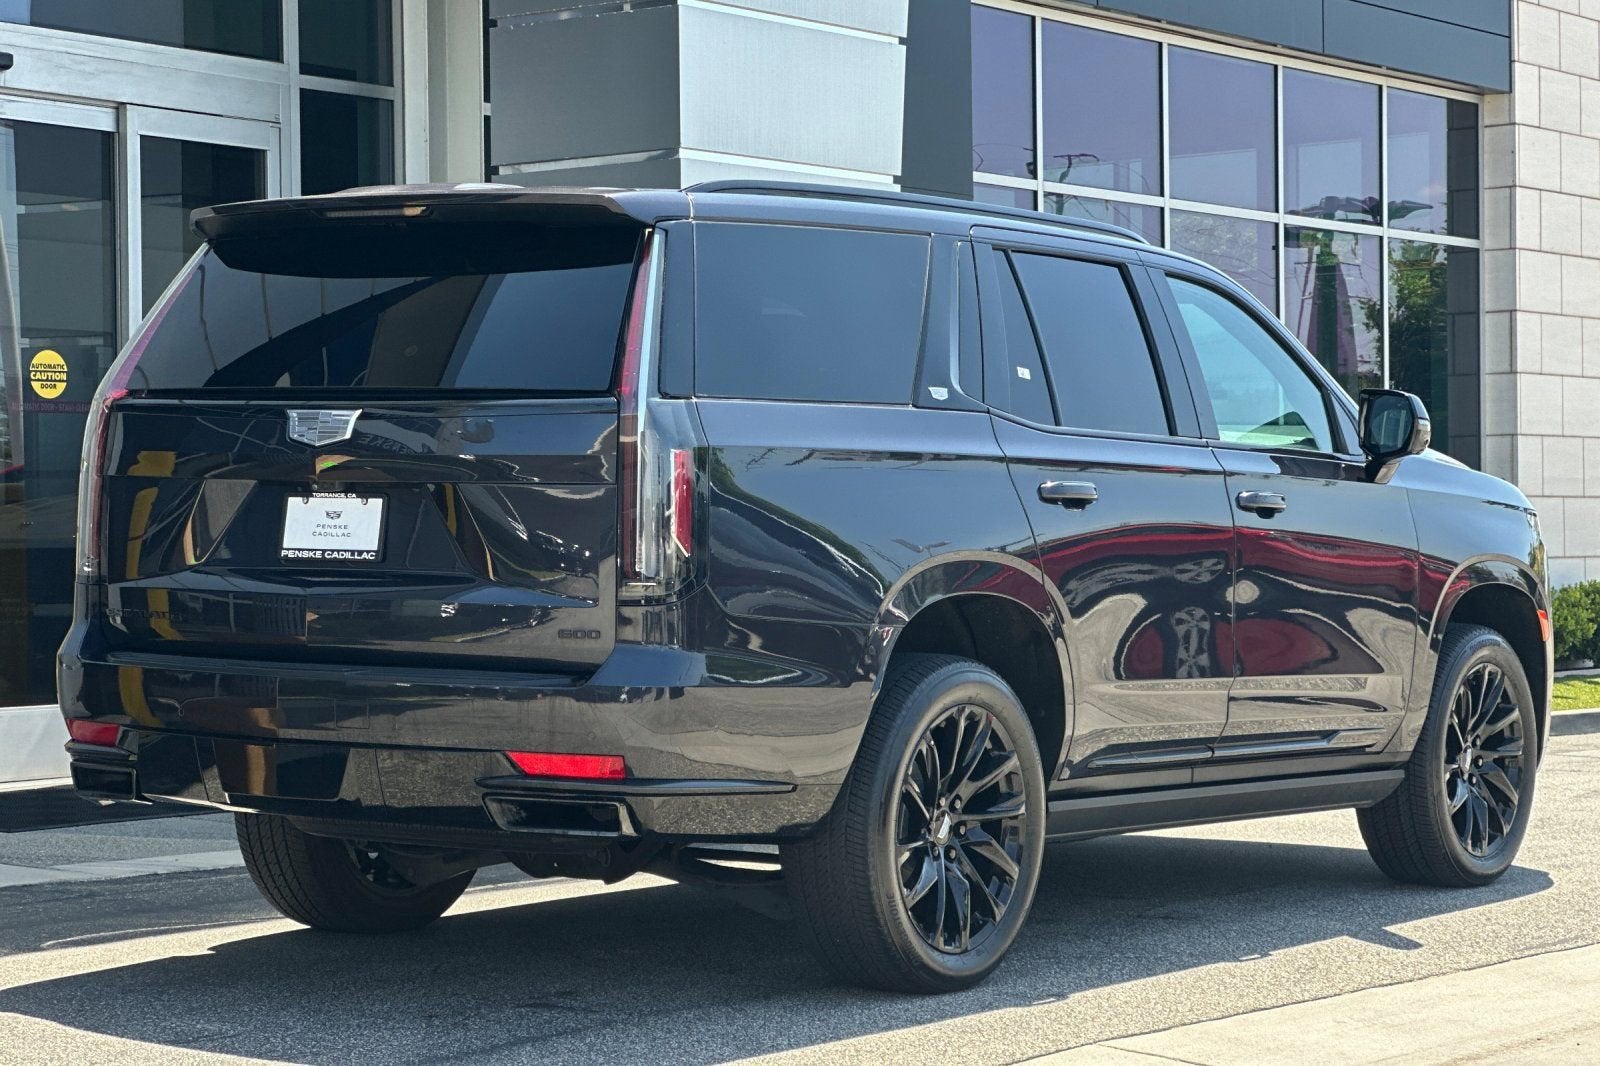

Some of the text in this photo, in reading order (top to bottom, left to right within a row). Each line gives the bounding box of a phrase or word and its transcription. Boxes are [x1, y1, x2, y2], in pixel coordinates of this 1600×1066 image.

[30, 372, 67, 381] CAUTION
[281, 549, 376, 560] PENSKE CADILLAC
[558, 629, 600, 639] 600
